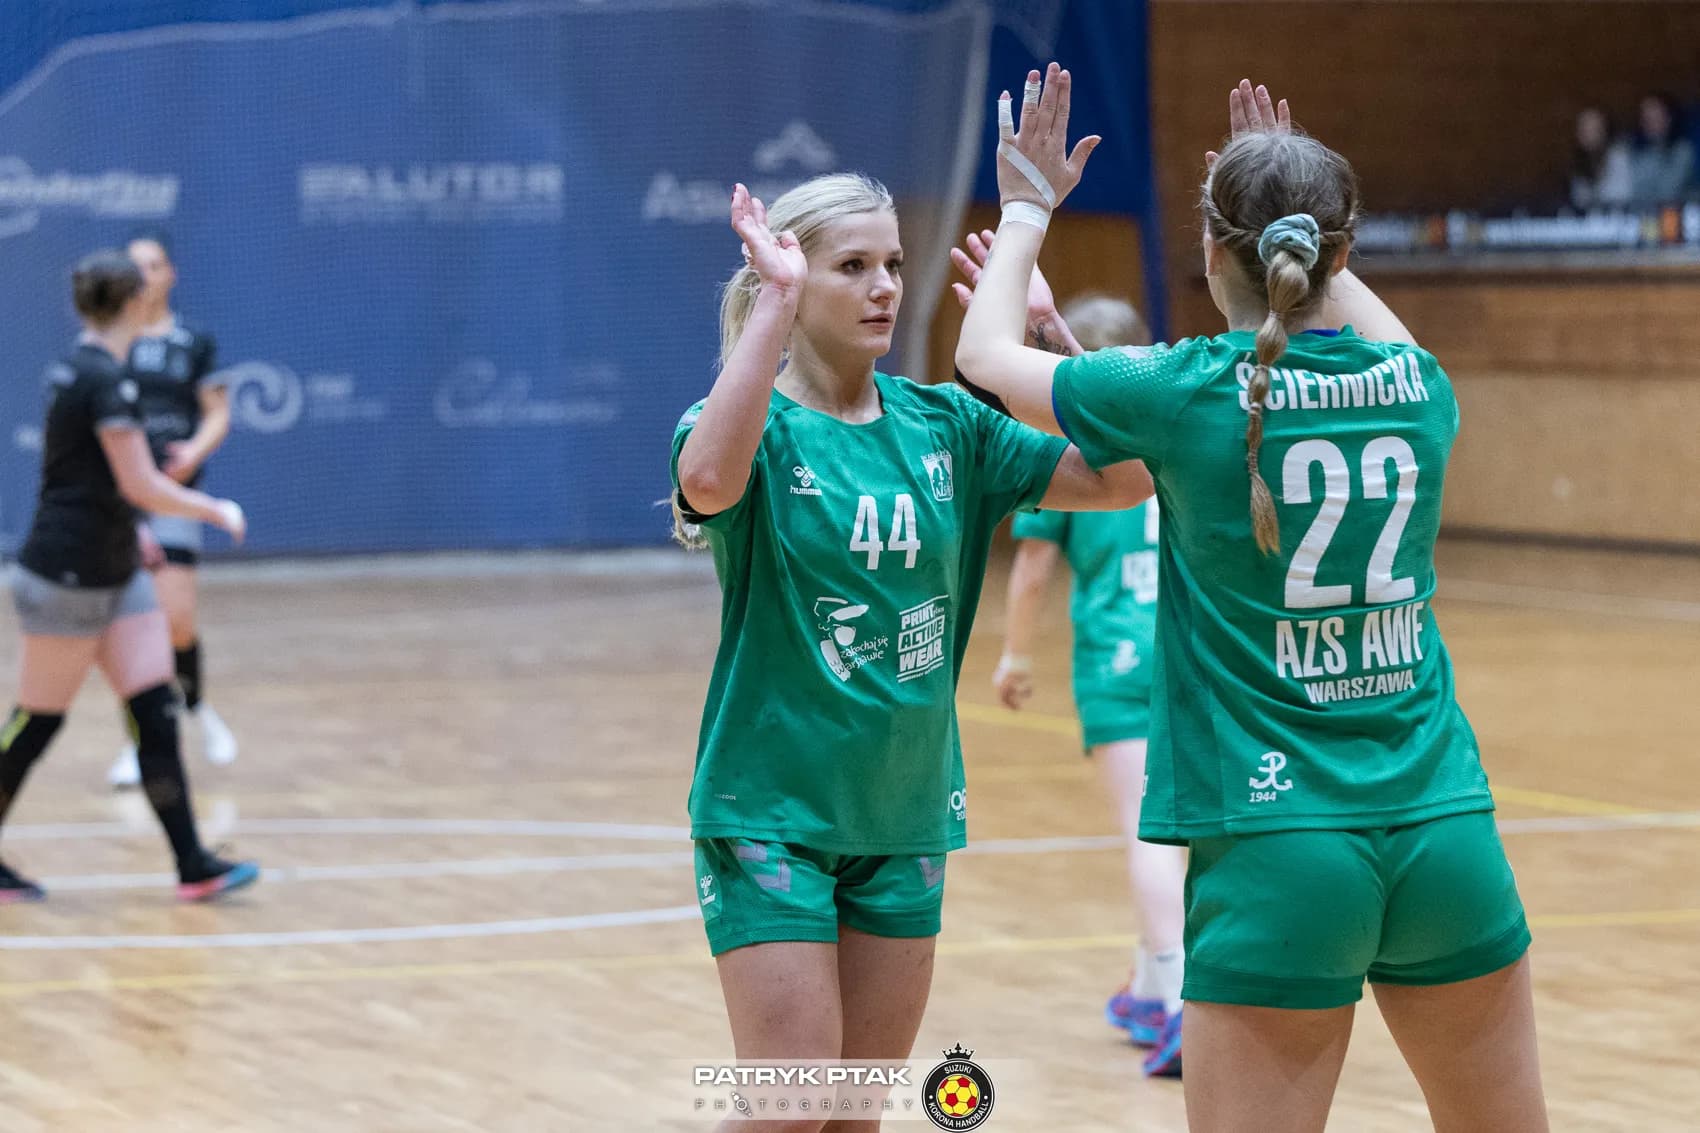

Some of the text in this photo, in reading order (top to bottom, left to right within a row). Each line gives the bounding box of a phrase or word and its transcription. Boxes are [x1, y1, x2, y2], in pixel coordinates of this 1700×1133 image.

[1235, 352, 1430, 412] ŚCIERNICKA
[849, 493, 921, 570] 44
[1282, 436, 1419, 609] 22
[901, 603, 934, 630] PRINT
[901, 615, 944, 649] ACTIVE
[899, 638, 943, 672] WEAR
[1275, 601, 1425, 679] AZS AWF
[1304, 669, 1416, 704] WARSZAWA
[1249, 791, 1277, 803] 1944
